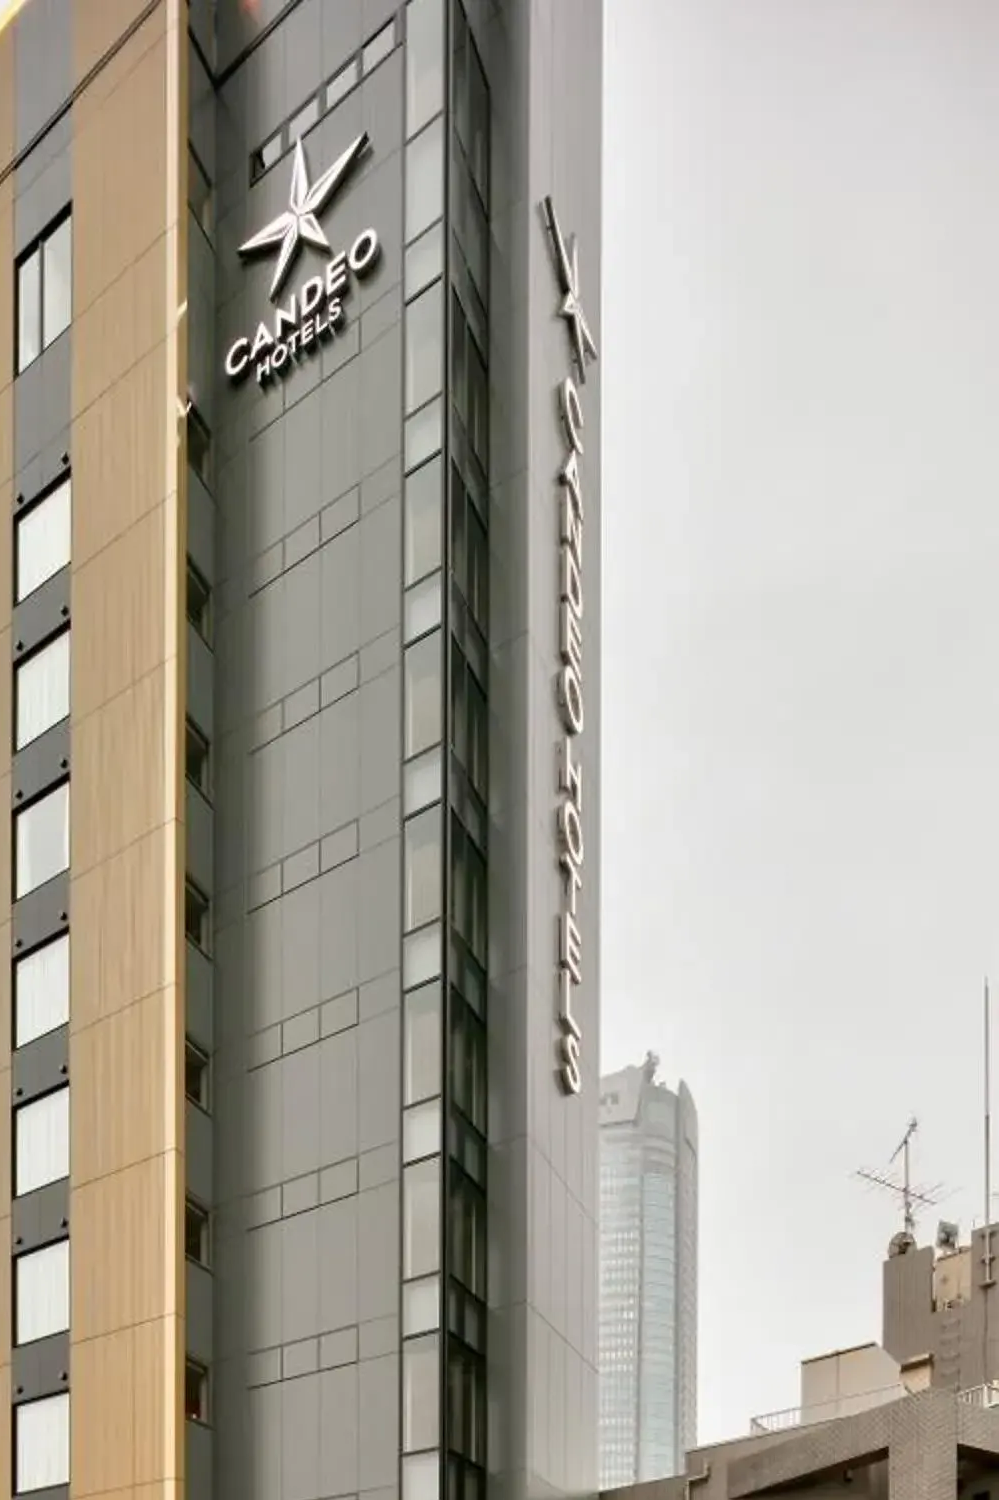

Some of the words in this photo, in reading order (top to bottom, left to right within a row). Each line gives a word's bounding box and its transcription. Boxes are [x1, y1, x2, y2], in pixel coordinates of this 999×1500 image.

[225, 228, 377, 375] CANDEO
[256, 297, 343, 382] HOTELS
[557, 377, 583, 734] CANDEO
[557, 737, 583, 1095] HOTELS
